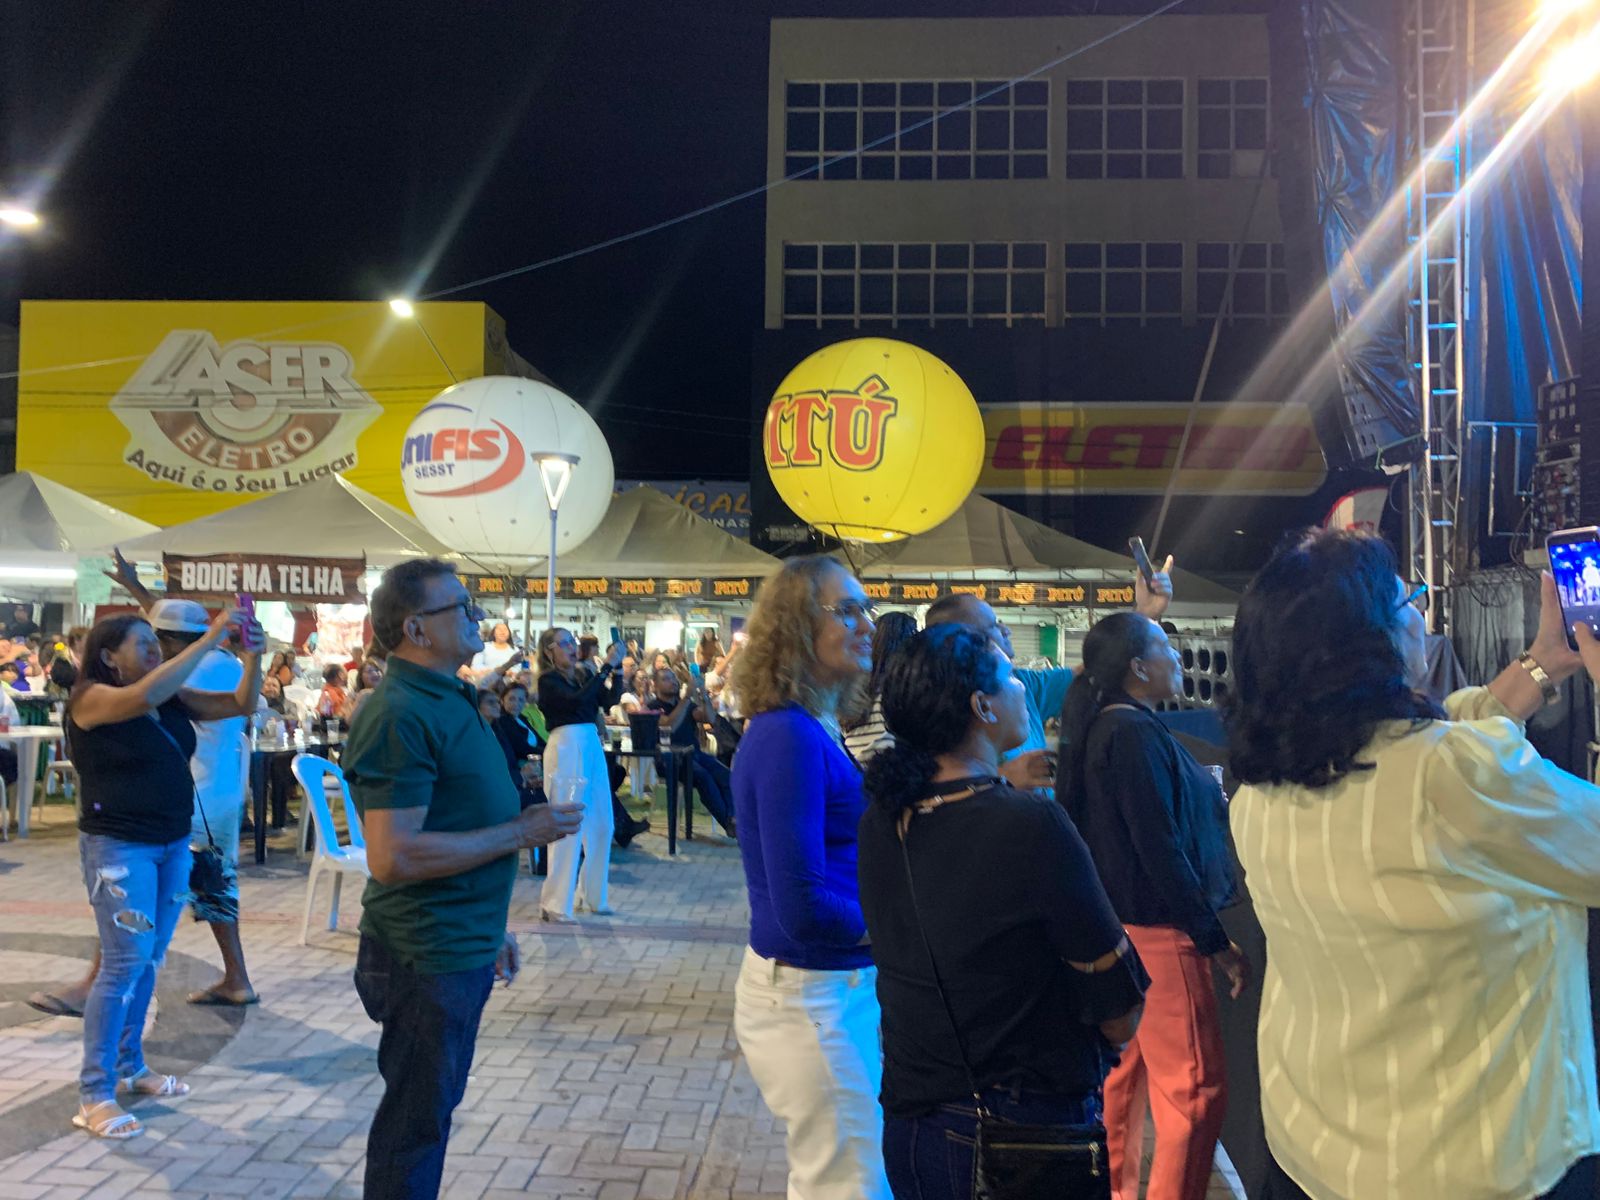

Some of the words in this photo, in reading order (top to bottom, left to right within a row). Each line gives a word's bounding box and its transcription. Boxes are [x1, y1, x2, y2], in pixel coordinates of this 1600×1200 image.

[149, 333, 363, 431] LASER
[178, 427, 314, 470] ELETRO
[126, 448, 186, 483] Aqui
[192, 470, 206, 489] é
[212, 479, 227, 492] o
[235, 474, 276, 492] Seu
[283, 452, 355, 488] Lugar
[414, 463, 455, 479] SESST
[181, 561, 238, 592] BODE
[243, 563, 273, 594] NA
[277, 564, 345, 596] TELHA
[573, 577, 608, 594] PITÚ
[620, 578, 655, 595] PITÚ
[714, 579, 749, 596] PITÚ
[903, 582, 938, 599] PITÚ
[1048, 585, 1085, 602] PITÚ
[1097, 586, 1134, 603] PITÚ
